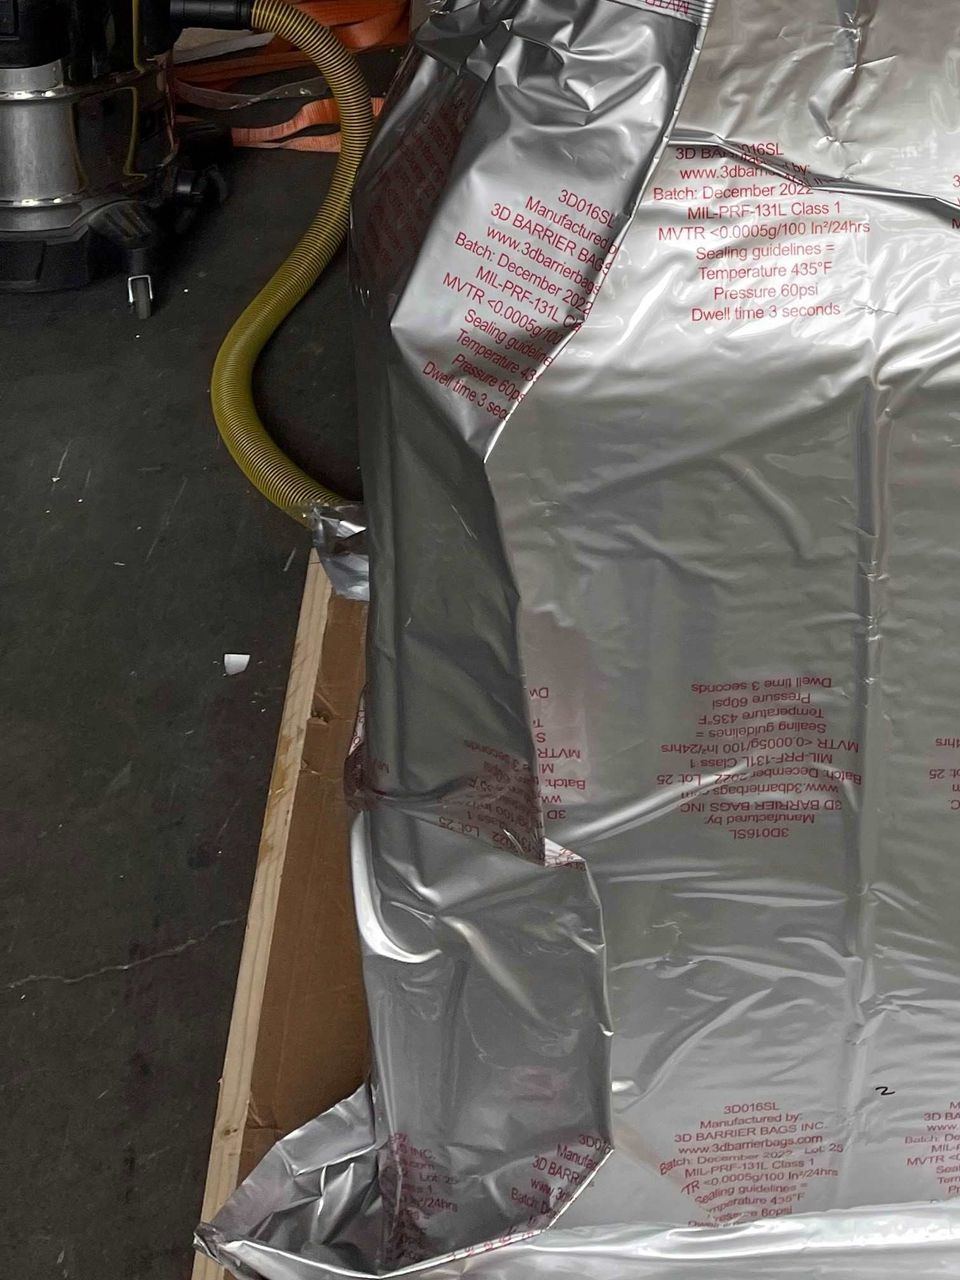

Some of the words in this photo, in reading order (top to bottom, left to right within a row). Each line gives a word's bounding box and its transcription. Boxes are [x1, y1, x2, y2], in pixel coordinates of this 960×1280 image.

[557, 189, 616, 229] 3D016SL
[688, 203, 787, 219] MIL-PRF-131L
[490, 202, 511, 221] 3D
[512, 213, 577, 256] BARRIER
[525, 195, 611, 250] Manufactured
[658, 226, 705, 239] MVTR
[497, 253, 563, 297] December
[699, 265, 787, 281] Temperature
[714, 287, 776, 299] Pressure
[929, 769, 945, 779] 25
[710, 802, 750, 812] BAGS
[755, 799, 820, 811] BARRIER
[728, 827, 789, 840] 3D016SL
